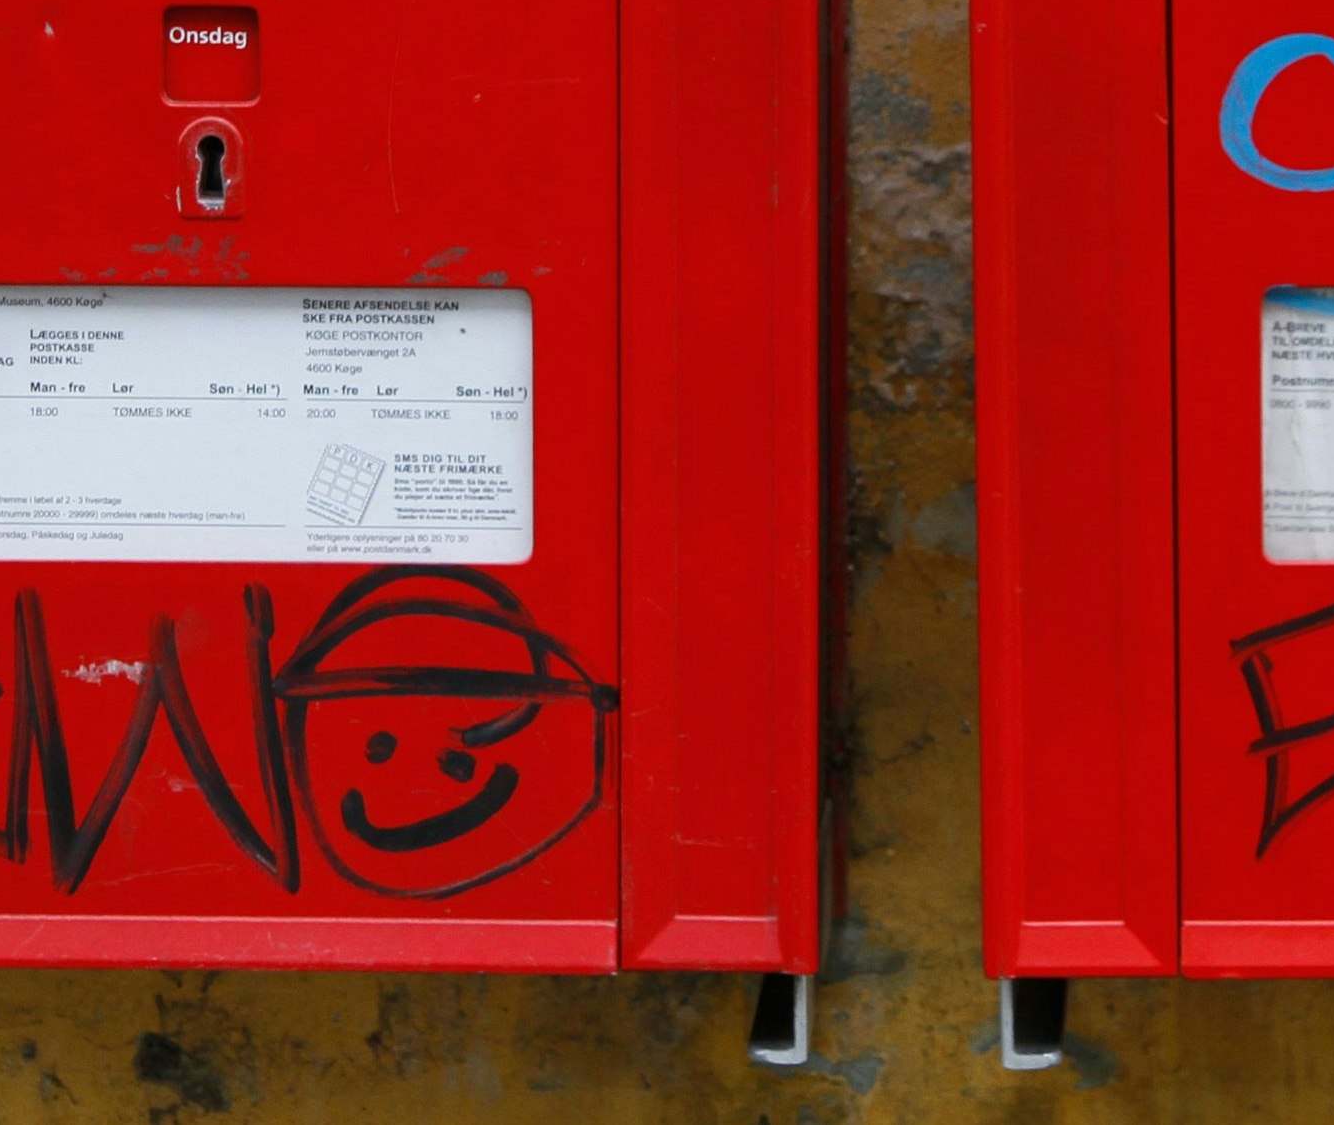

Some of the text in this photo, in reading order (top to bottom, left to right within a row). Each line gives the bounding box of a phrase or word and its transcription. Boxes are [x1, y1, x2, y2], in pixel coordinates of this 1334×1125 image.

[168, 26, 248, 49] Onsdag
[47, 297, 72, 306] 4600
[75, 297, 104, 308] Køge
[303, 299, 459, 311] SENERE AFSENDELSE KAN
[303, 314, 434, 324] SKE FRA POSTKASSEN
[30, 329, 78, 340] LÆGGES
[88, 331, 124, 340] DENNE
[306, 331, 422, 341] KØGE POSTKONTOR
[30, 344, 95, 352] POSTKASSE
[402, 348, 416, 357] 2A
[30, 356, 83, 365] INDEN KL:
[306, 364, 362, 375] 4600 Køge
[30, 382, 86, 393] Man fre
[113, 383, 133, 394] Lør
[209, 384, 234, 394] Søn
[246, 384, 267, 394] Hel
[303, 385, 358, 395] Man fre
[377, 385, 398, 396] Lør
[456, 386, 481, 397] Søn
[493, 386, 514, 398] Hel
[30, 407, 59, 417] 18:00
[113, 407, 193, 417] TØMMES IKKE
[257, 408, 286, 418] 14:00
[307, 408, 336, 418] 20:00
[371, 409, 451, 420] TØMMES IKKE
[490, 411, 518, 420] 18:00
[394, 465, 503, 474] NÆSTE FRIMÆRKE
